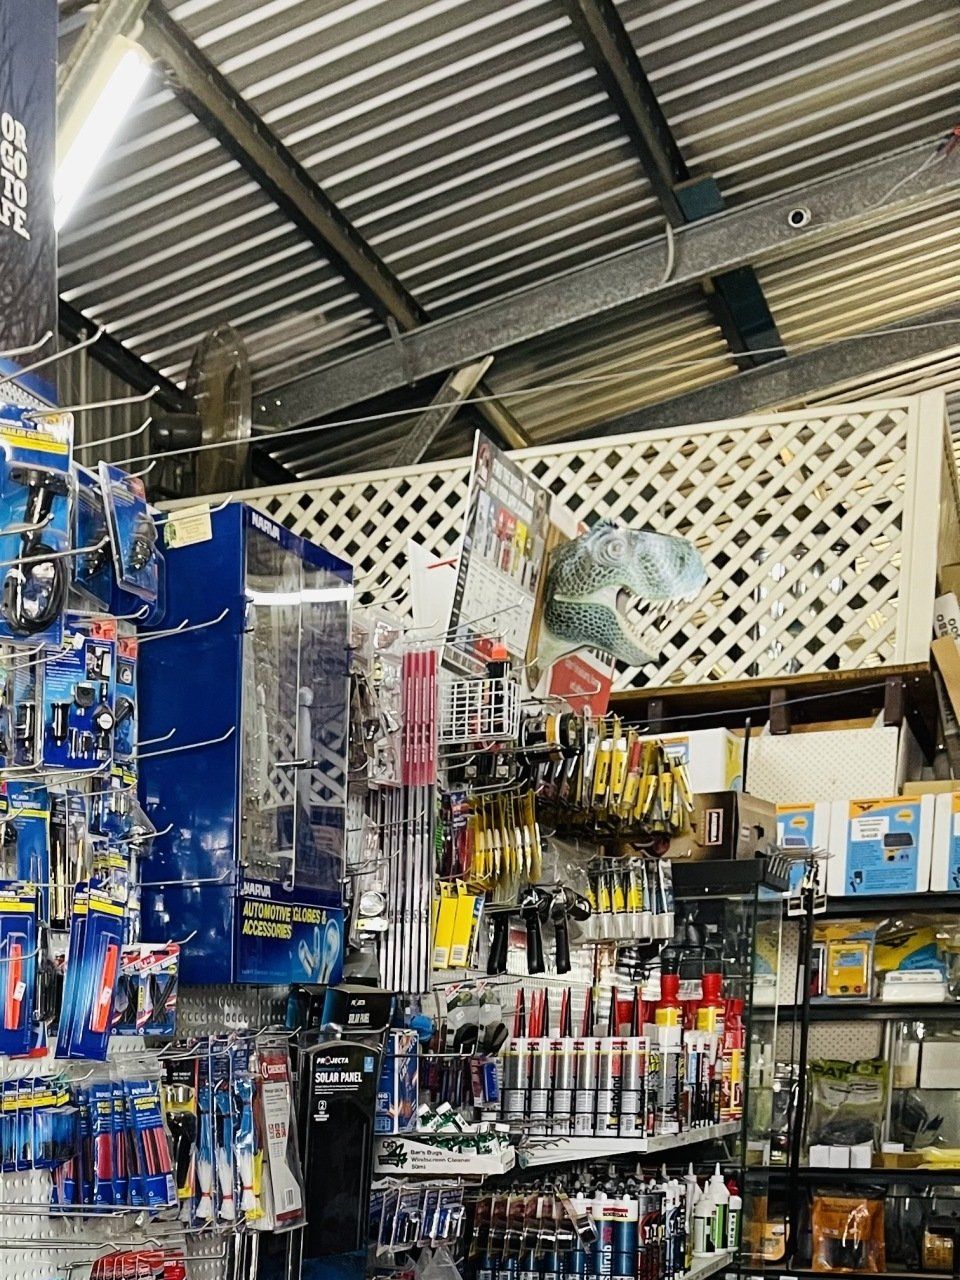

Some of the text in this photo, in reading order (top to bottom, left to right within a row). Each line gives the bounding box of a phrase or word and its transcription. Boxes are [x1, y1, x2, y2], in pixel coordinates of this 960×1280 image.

[1, 112, 27, 153] OR
[0, 141, 27, 179] GO
[1, 169, 27, 208] TO
[251, 511, 281, 542] NARVA
[243, 881, 271, 898] NARVA
[243, 901, 327, 925] AUTOMOTIVE GLOBES &
[242, 919, 292, 939] ACCESSORIES
[315, 1072, 362, 1083] SOLAR PANEL
